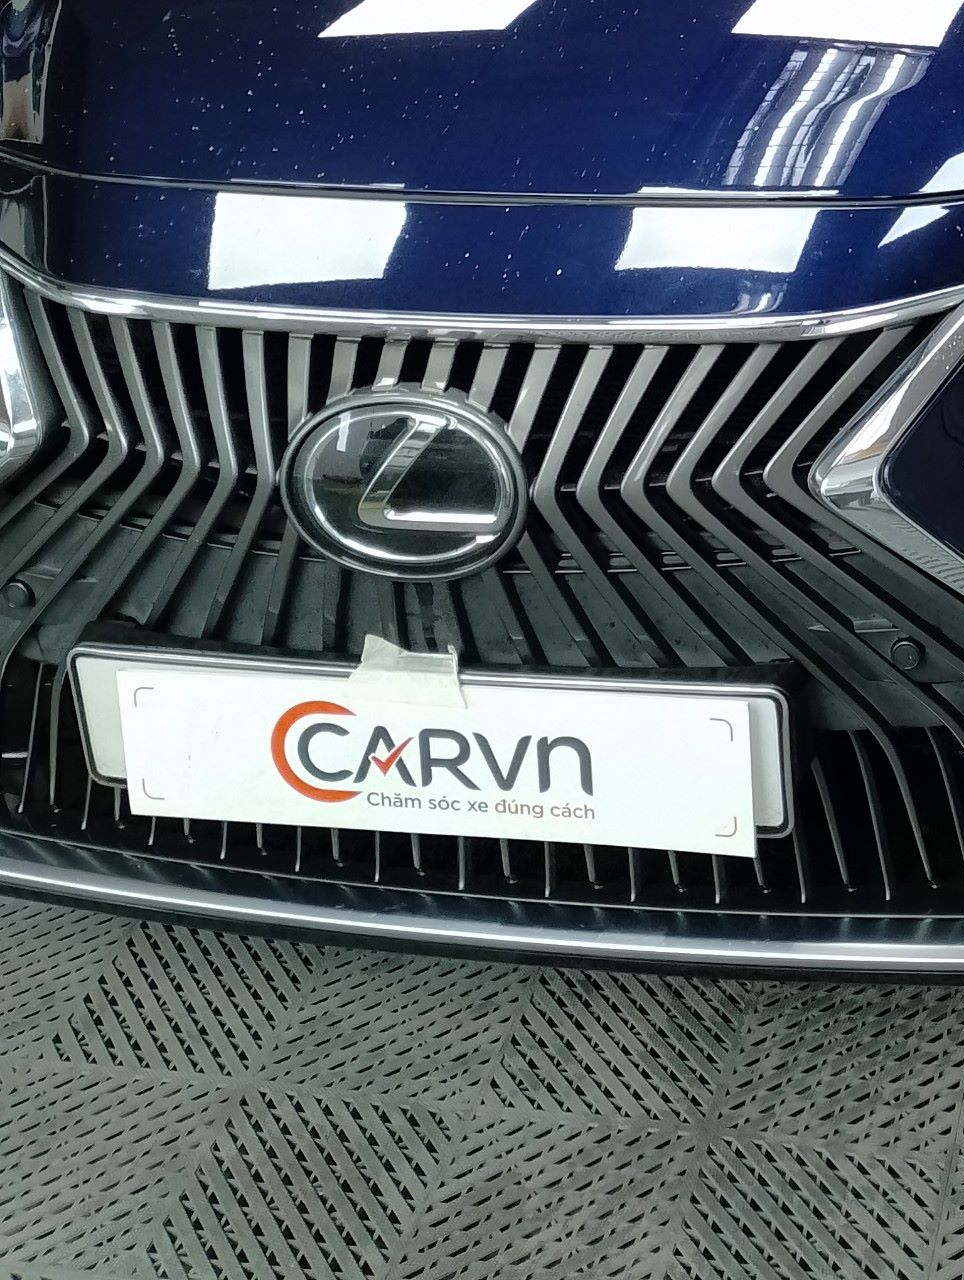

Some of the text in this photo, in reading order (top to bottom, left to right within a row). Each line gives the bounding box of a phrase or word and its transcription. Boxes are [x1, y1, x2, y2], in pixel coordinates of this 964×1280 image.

[366, 791, 595, 820] Chăm sóc xe đúng cách
